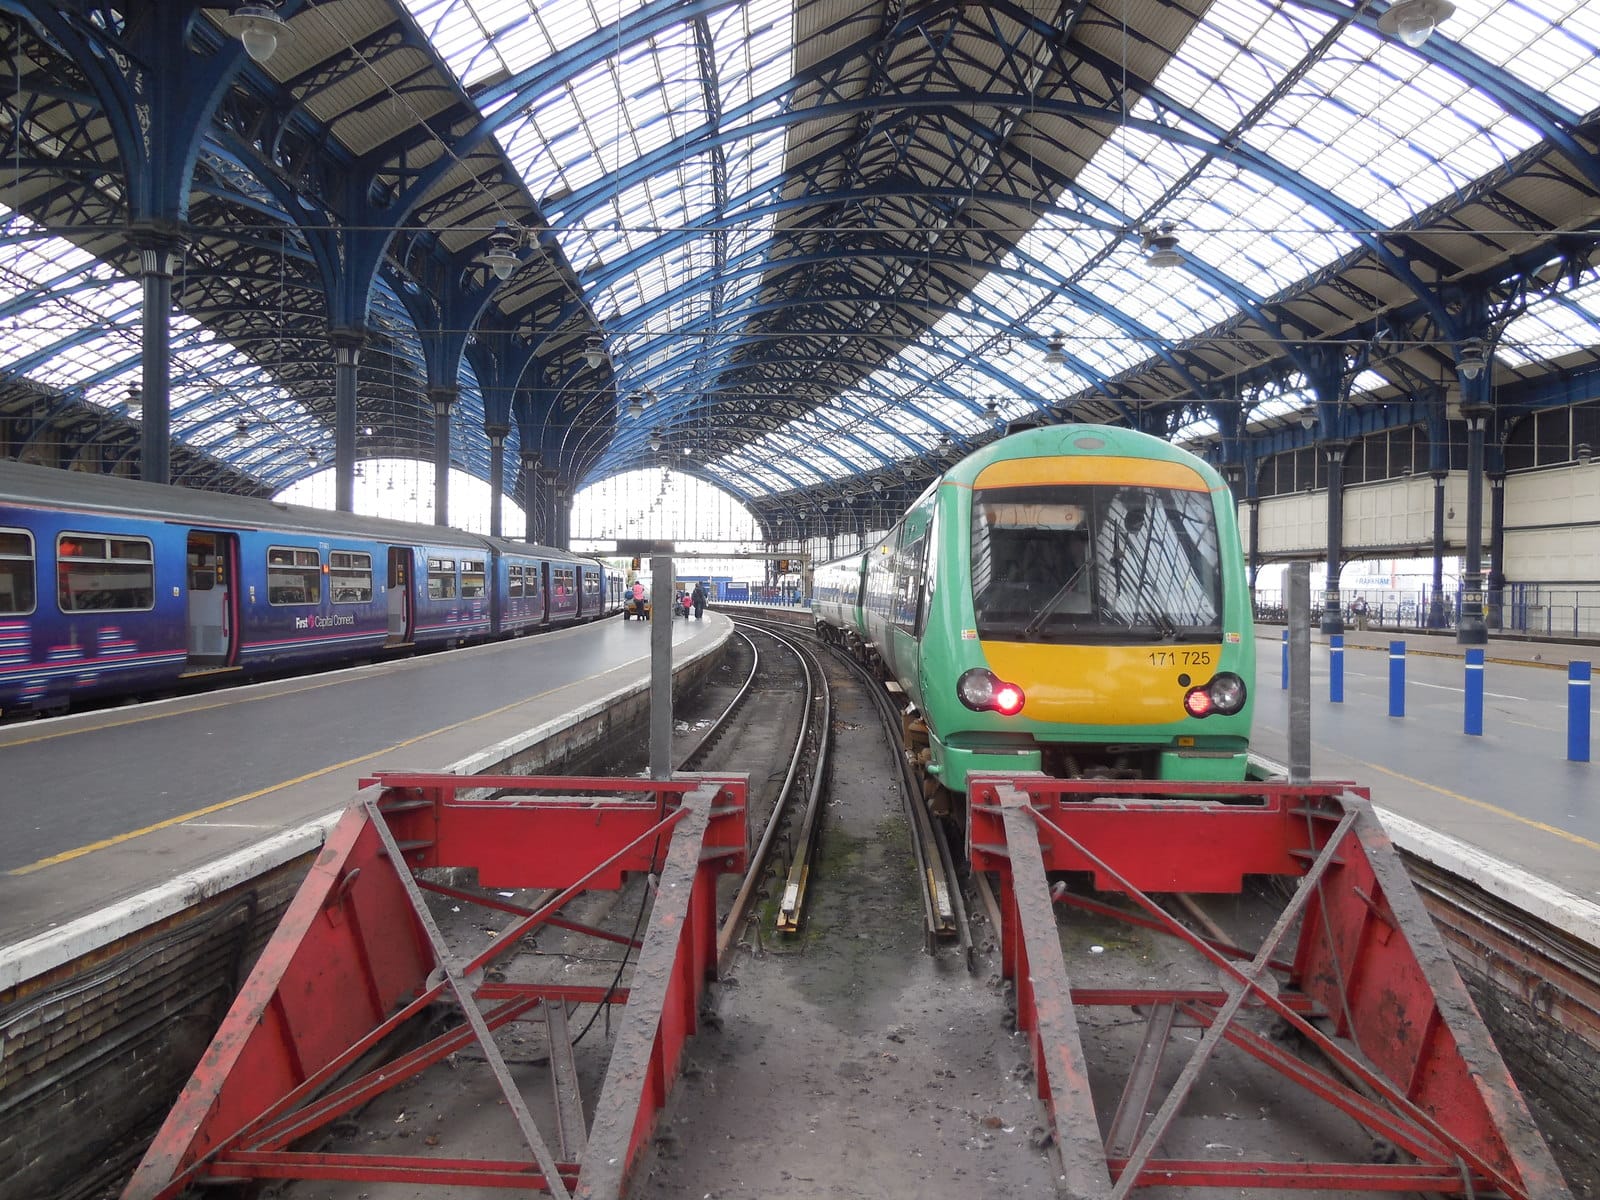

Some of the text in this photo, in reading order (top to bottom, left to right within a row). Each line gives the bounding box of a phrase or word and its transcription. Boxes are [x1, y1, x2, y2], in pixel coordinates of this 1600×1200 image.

[296, 614, 354, 629] First Capital Connect
[1149, 651, 1210, 666] 171 725
